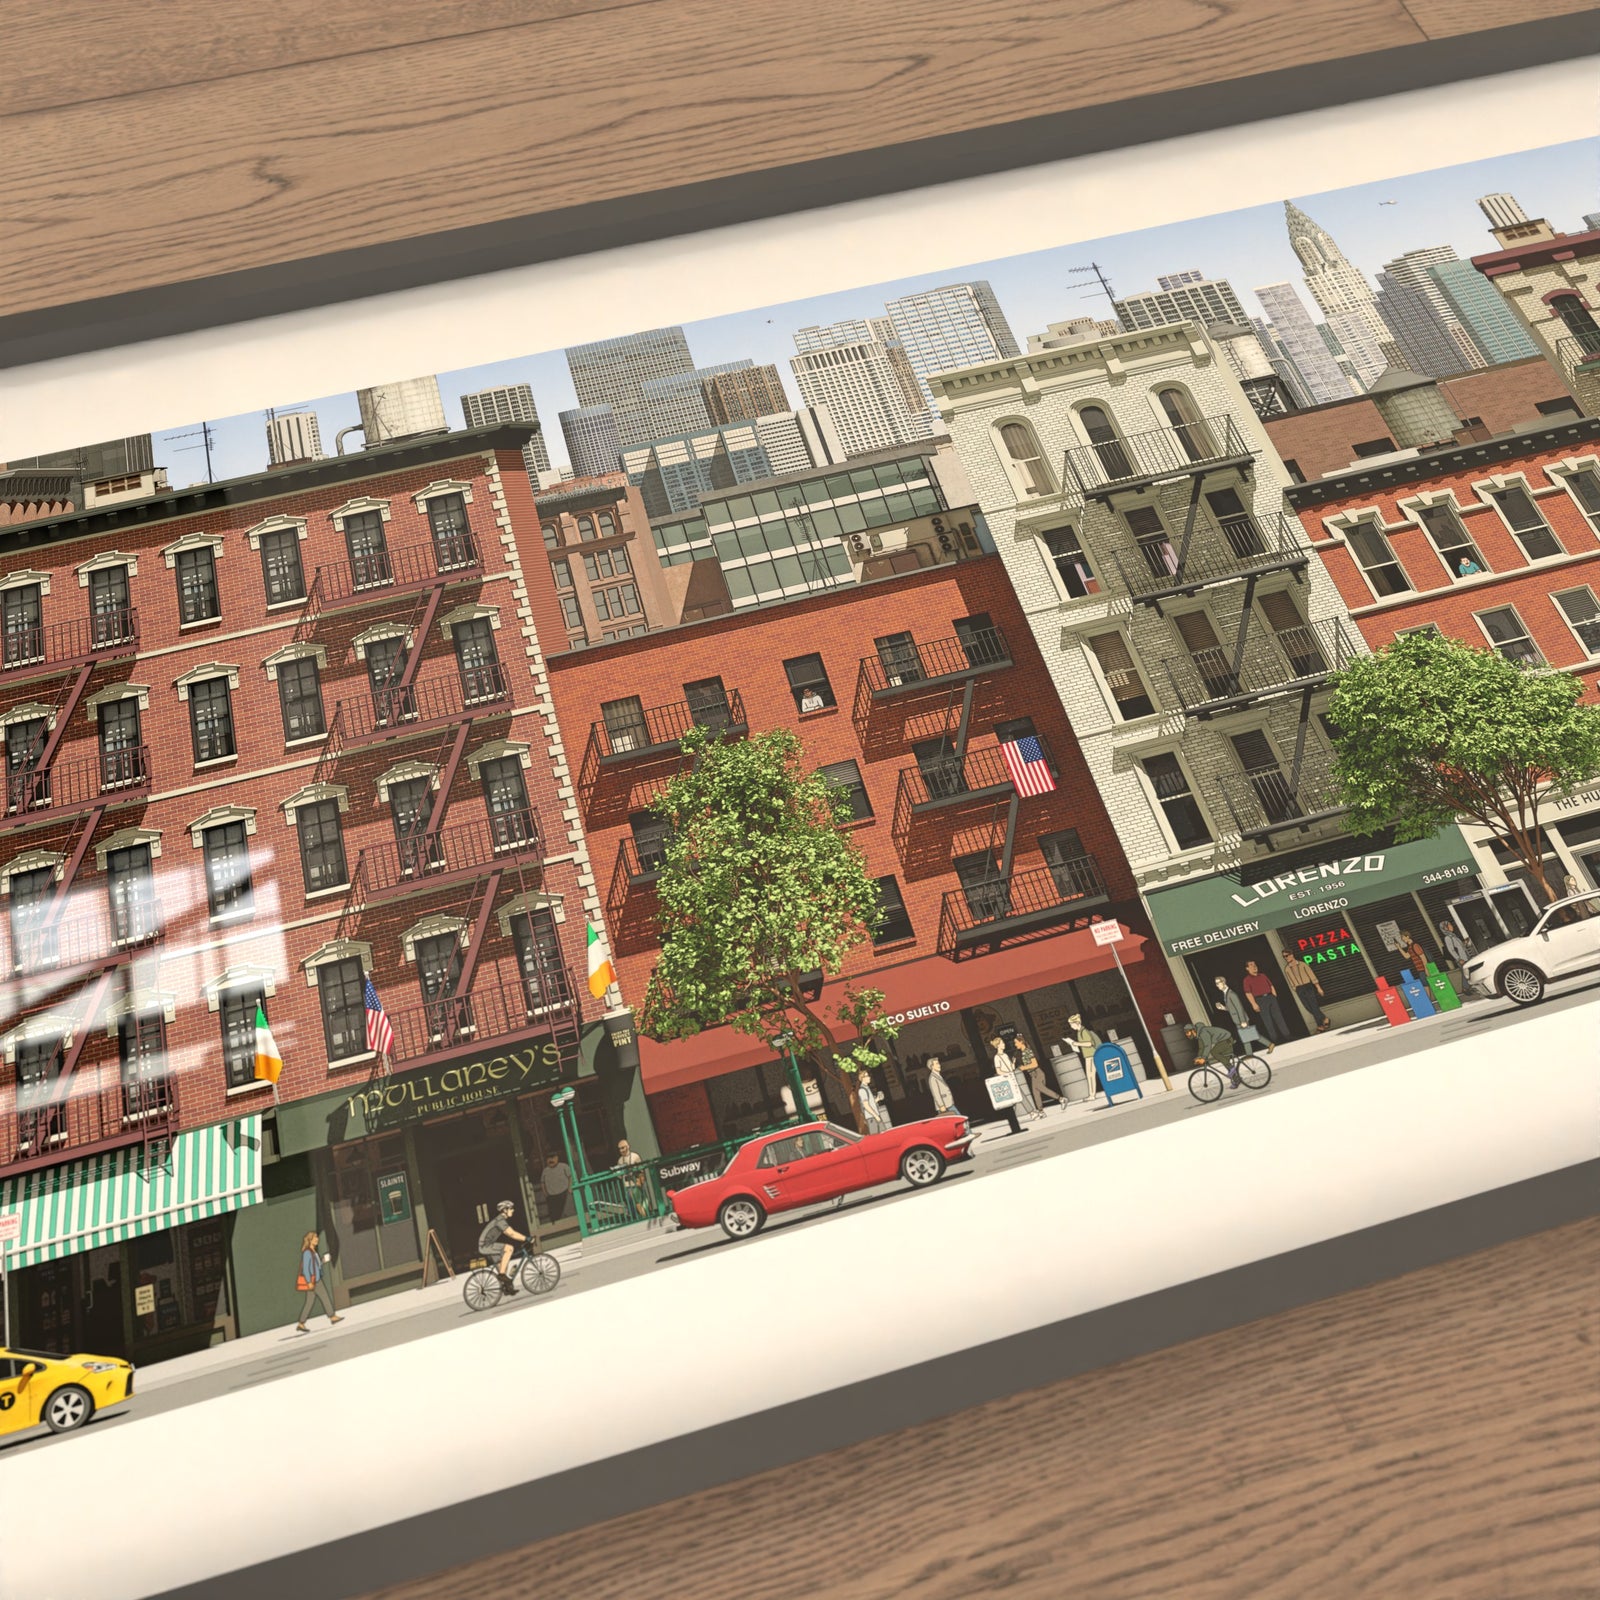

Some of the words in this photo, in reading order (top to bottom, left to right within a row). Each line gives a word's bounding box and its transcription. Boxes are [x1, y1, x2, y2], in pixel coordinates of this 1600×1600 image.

[1553, 796, 1580, 811] THE
[1231, 854, 1385, 907] LORENZO
[1422, 864, 1470, 884] 344-8149
[1289, 888, 1316, 901] EST.
[1319, 880, 1346, 893] 1956
[1294, 897, 1349, 919] LORENZO
[1171, 936, 1203, 953] FREE
[1203, 920, 1260, 944] DELIVERY
[1297, 928, 1351, 951] PIZZA
[1303, 943, 1361, 966] PASTA
[870, 1013, 905, 1030] TCO
[906, 1001, 950, 1020] SUELTO
[613, 1037, 631, 1047] PINT
[1000, 1027, 1014, 1036] OPEN
[417, 1096, 457, 1115] PUBLIC
[461, 1085, 501, 1106] HOUSE
[660, 1161, 701, 1179] Subway
